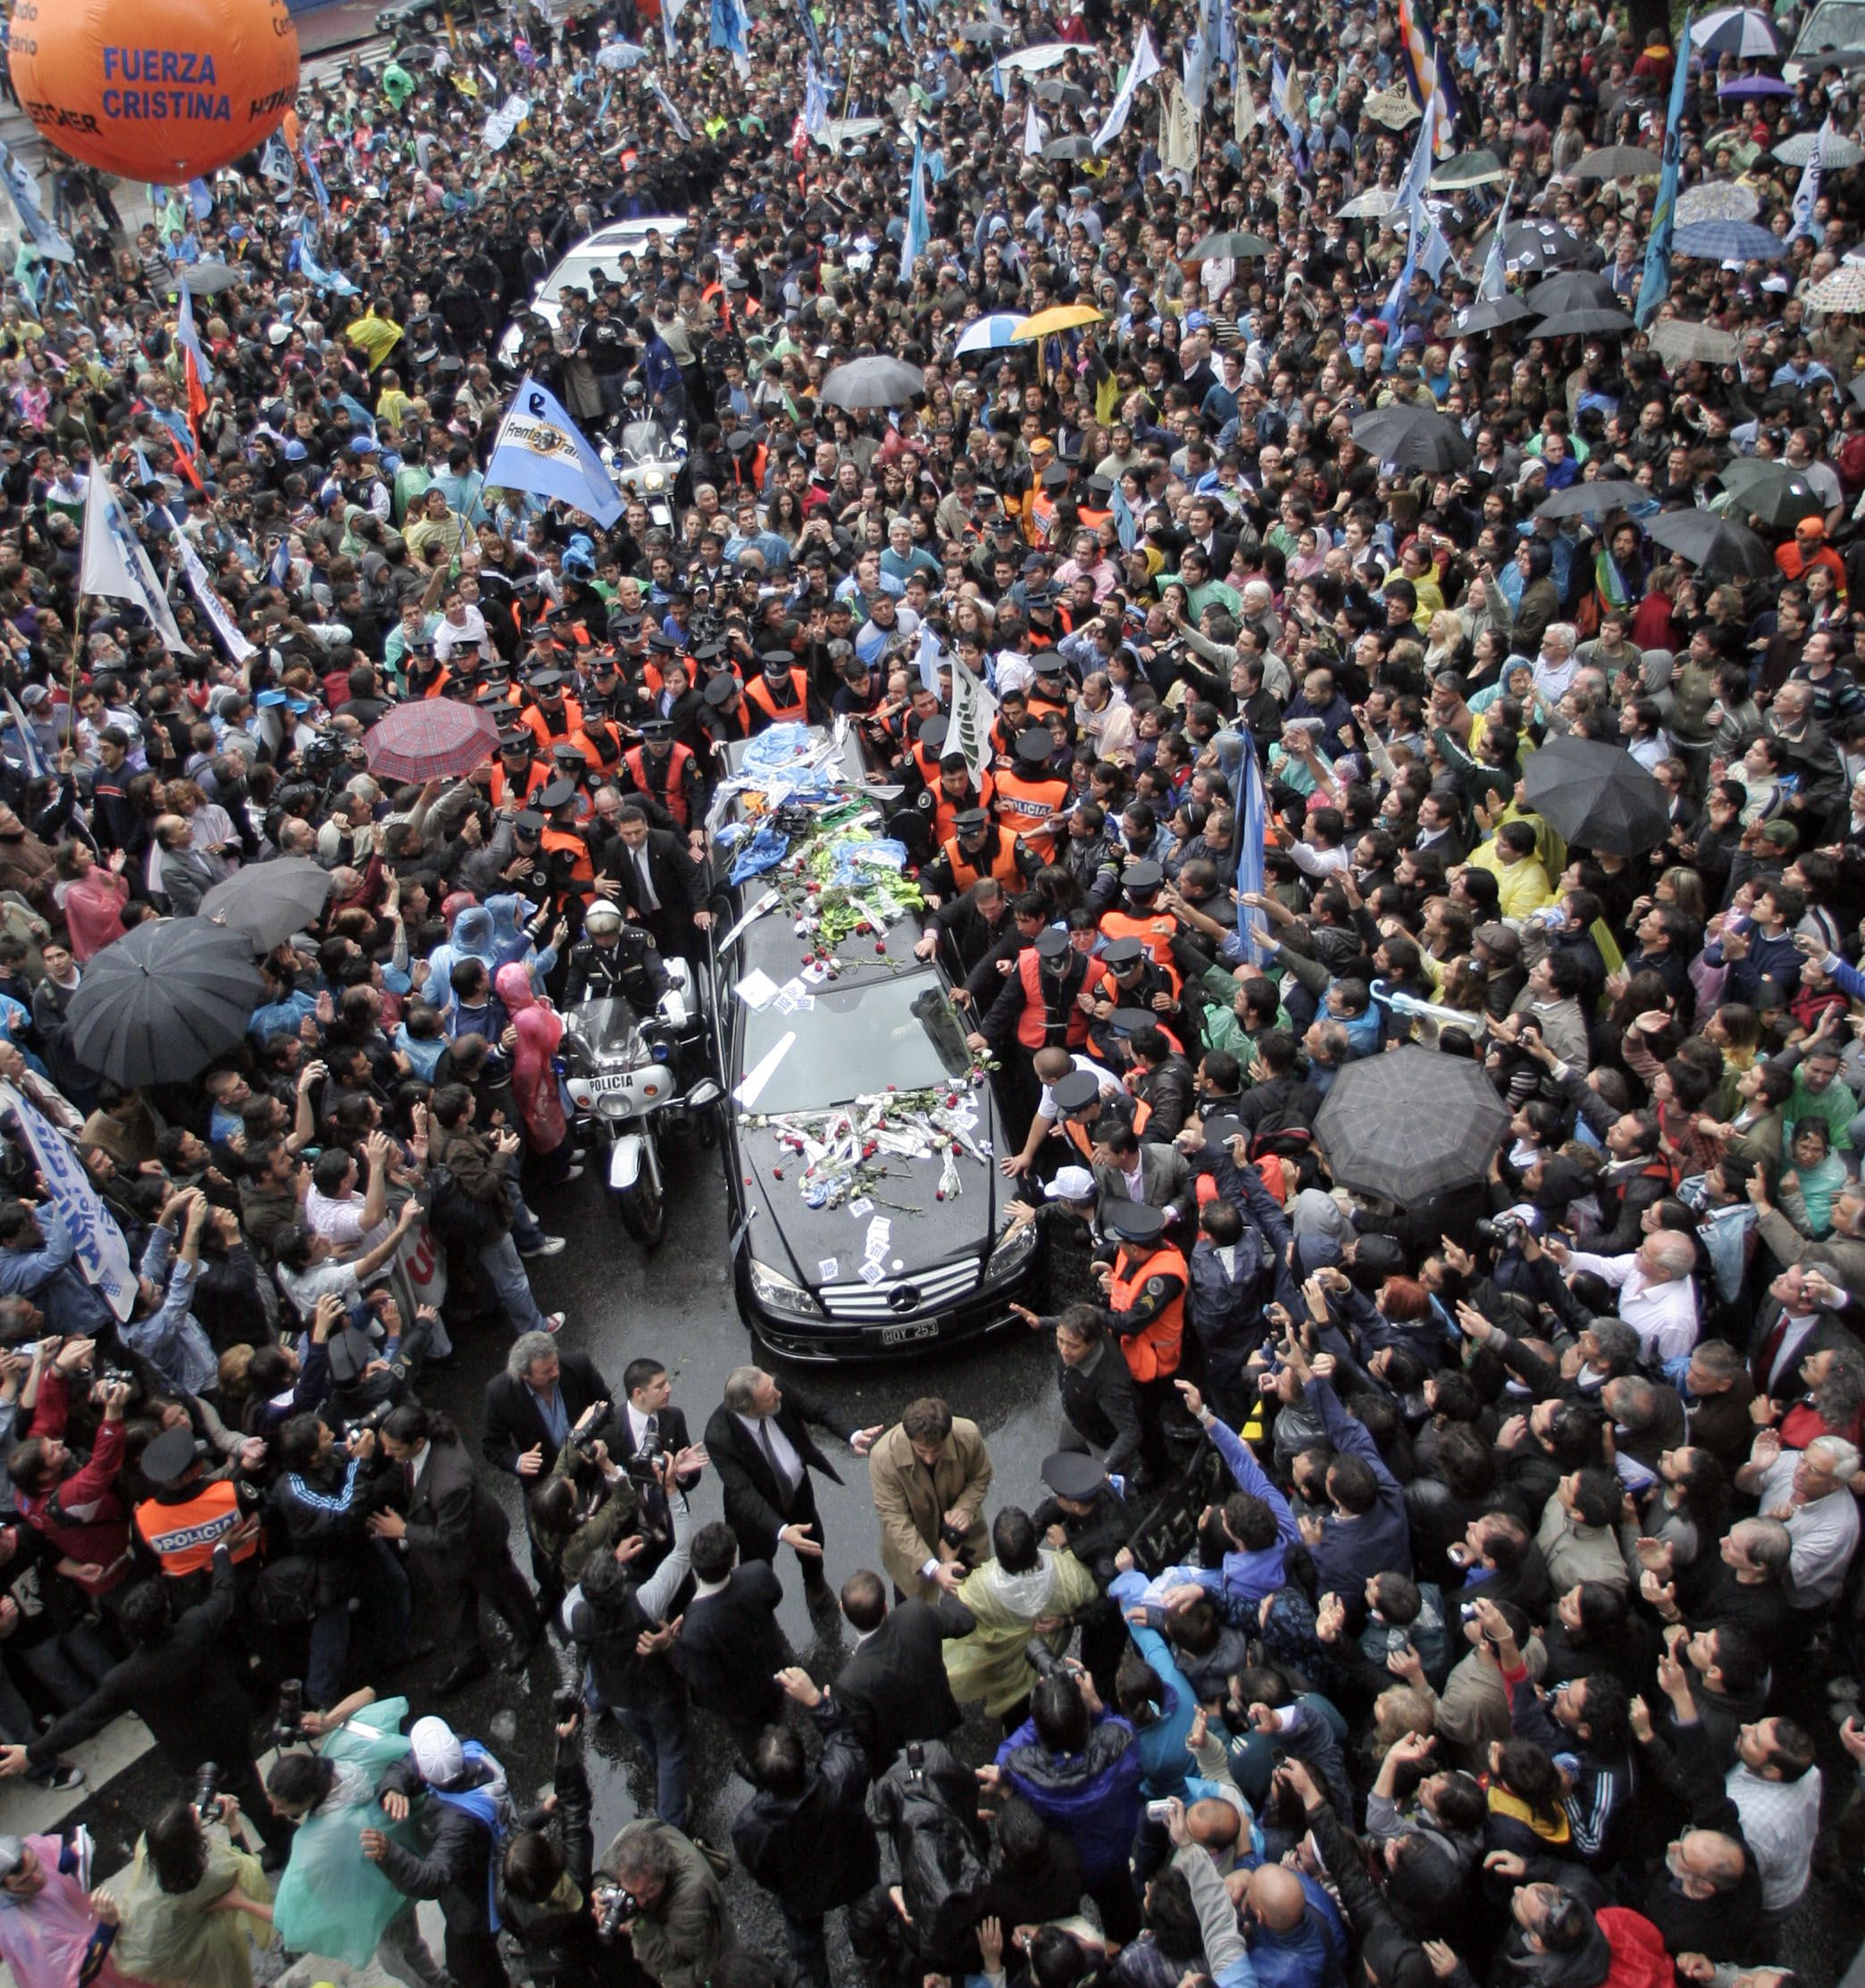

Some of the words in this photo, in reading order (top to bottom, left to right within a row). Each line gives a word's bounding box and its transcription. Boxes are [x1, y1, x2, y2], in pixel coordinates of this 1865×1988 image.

[104, 47, 216, 85] FUERZA
[103, 89, 230, 122] CRISTINA
[590, 1074, 633, 1093] POLICIA
